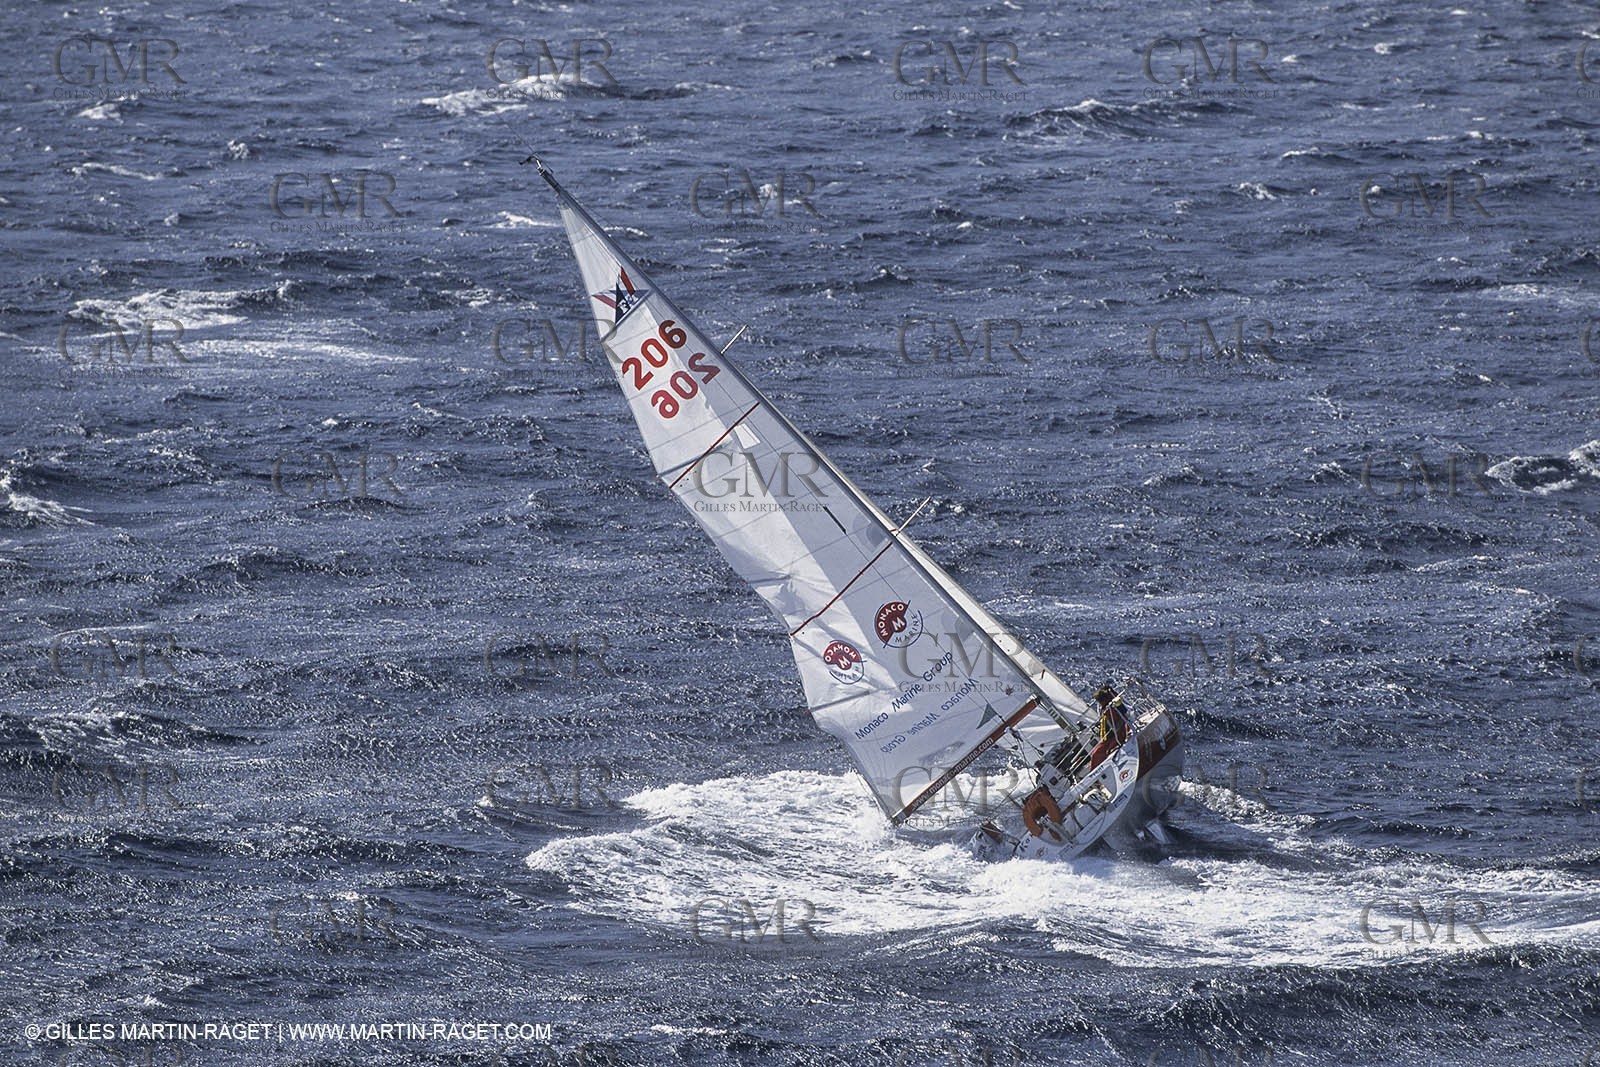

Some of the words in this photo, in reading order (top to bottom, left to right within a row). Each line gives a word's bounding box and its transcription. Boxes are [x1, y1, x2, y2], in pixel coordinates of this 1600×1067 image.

[622, 320, 687, 390] 206
[878, 603, 905, 637] MONACO
[895, 614, 919, 643] MARINE
[855, 712, 889, 740] Monaco
[891, 682, 922, 712] Marine
[922, 651, 953, 682] Group
